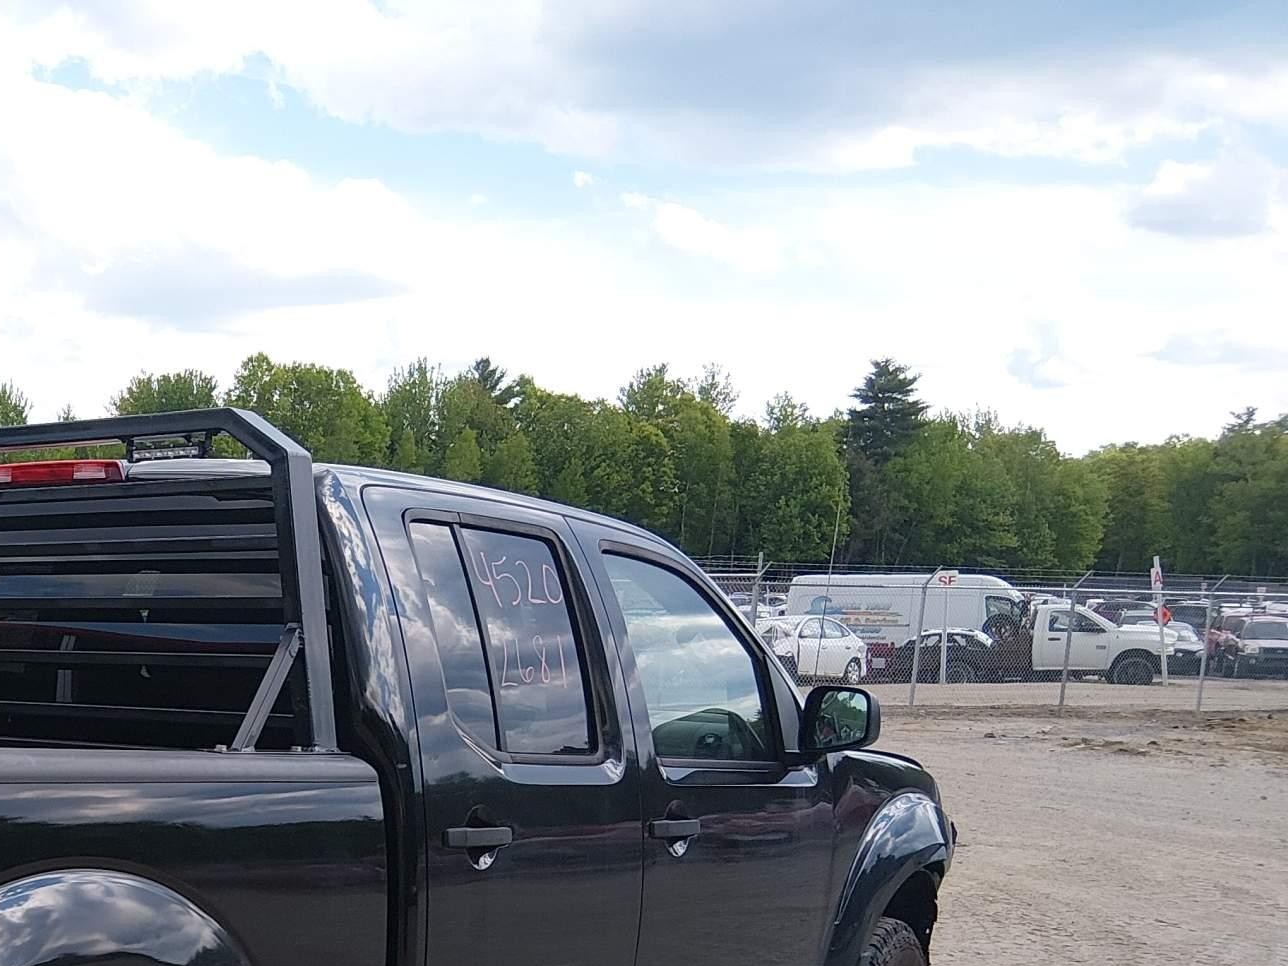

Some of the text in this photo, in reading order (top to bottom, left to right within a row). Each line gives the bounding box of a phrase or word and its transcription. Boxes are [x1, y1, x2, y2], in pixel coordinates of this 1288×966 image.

[468, 545, 563, 608] 4520
[1154, 570, 1162, 586] A
[501, 634, 567, 689] 2681
